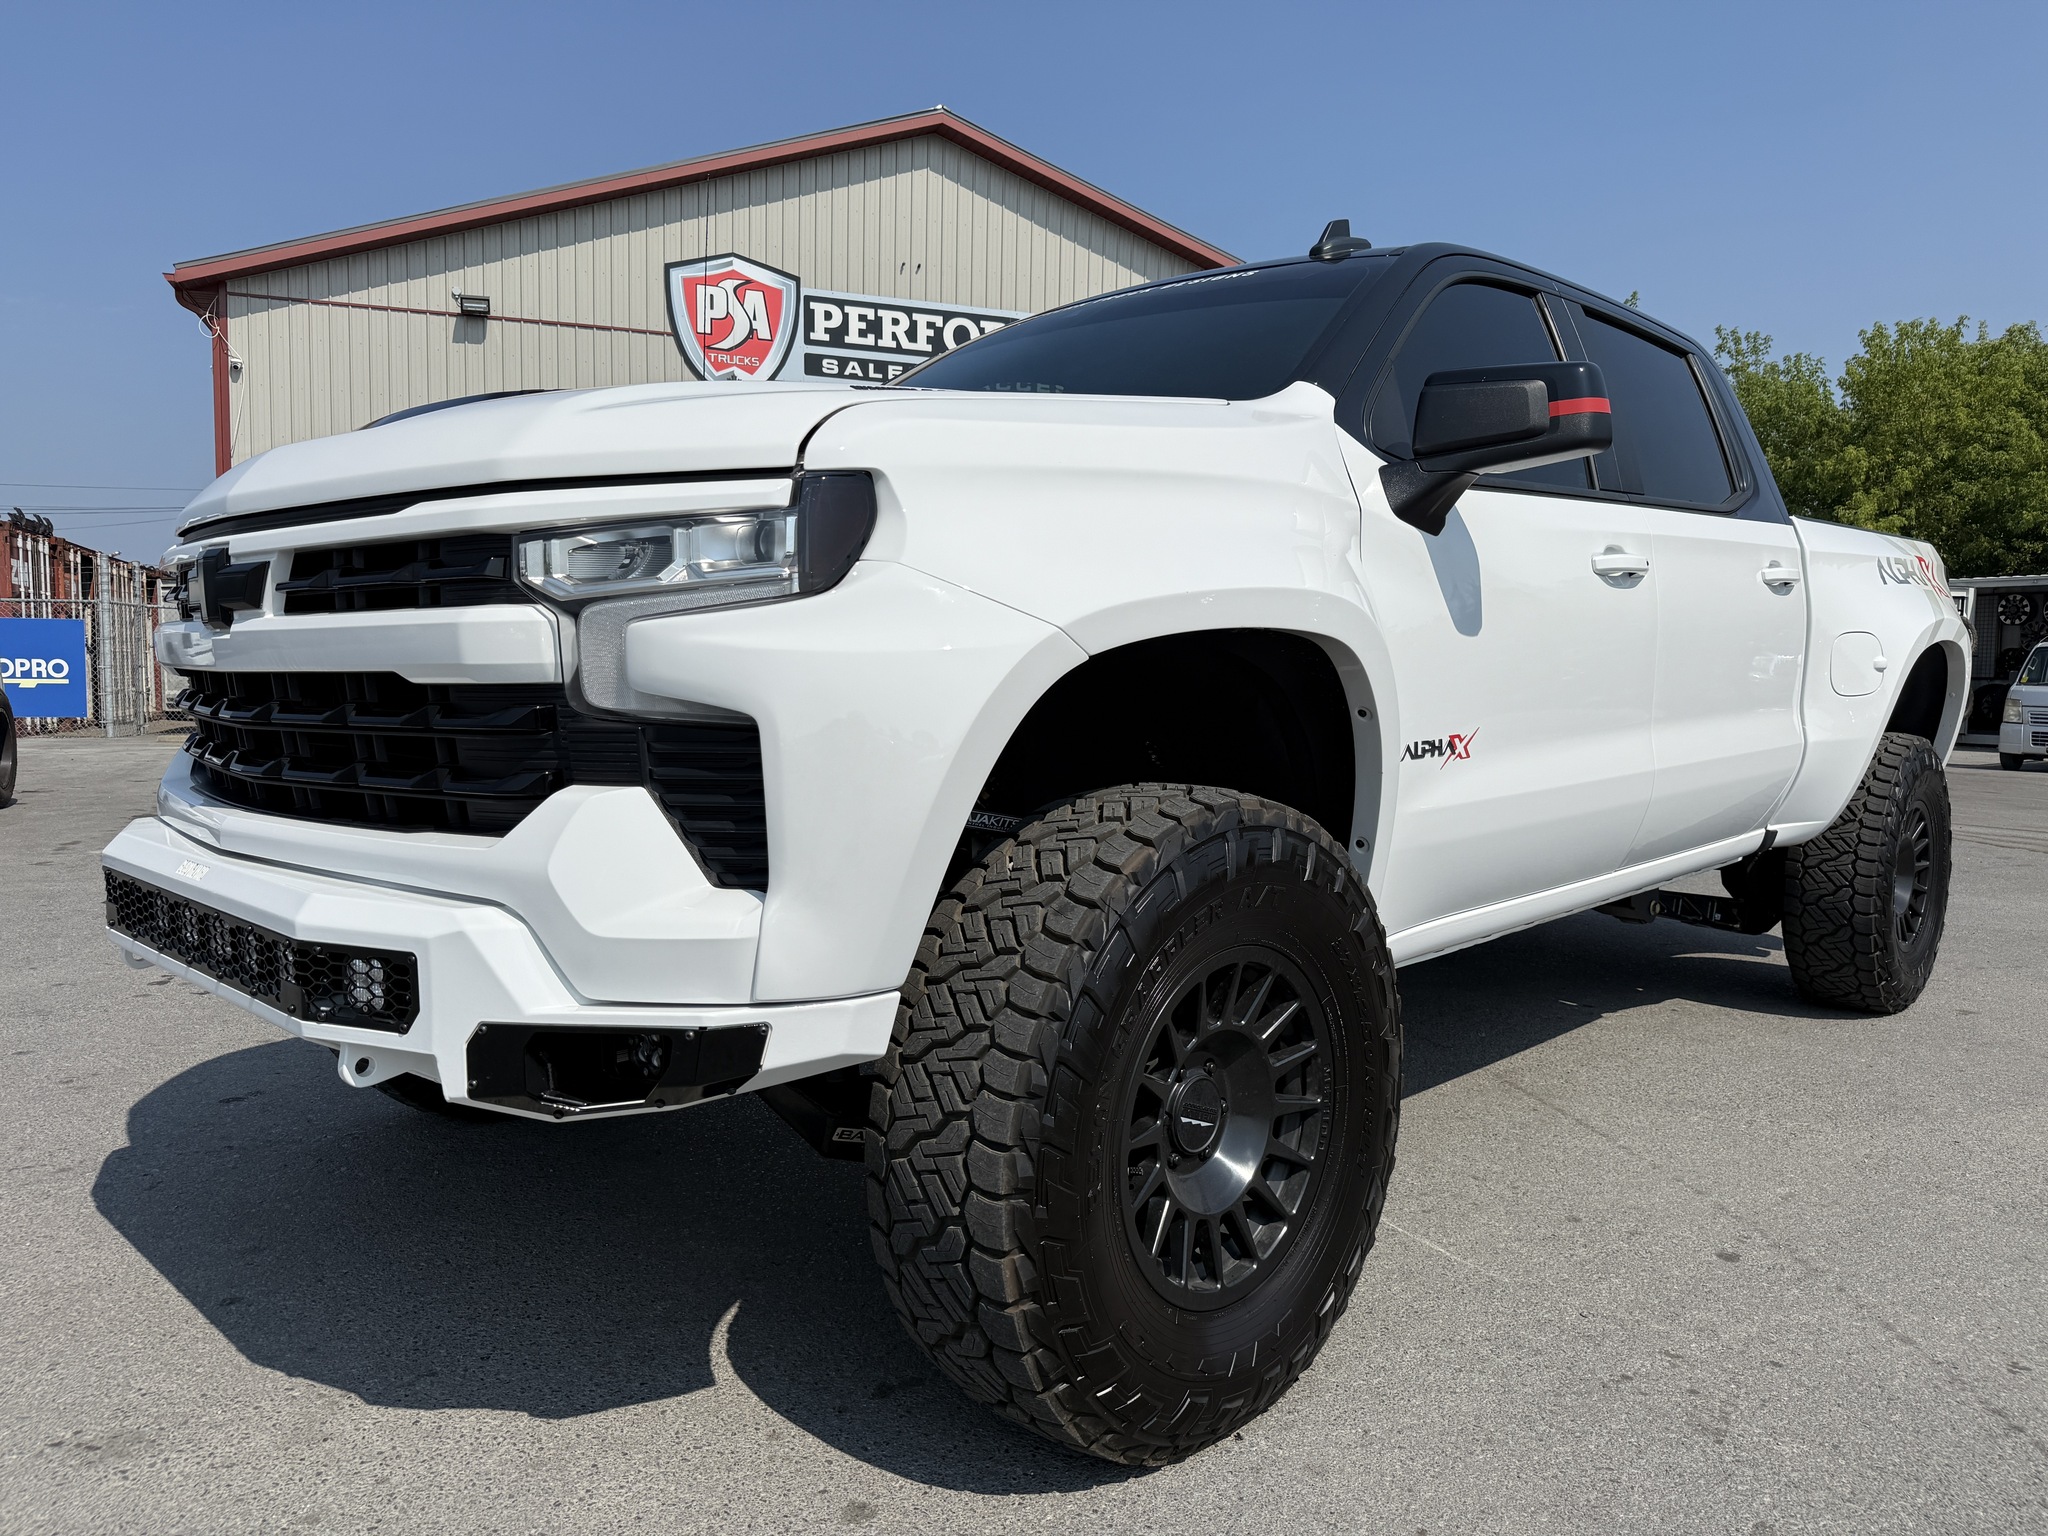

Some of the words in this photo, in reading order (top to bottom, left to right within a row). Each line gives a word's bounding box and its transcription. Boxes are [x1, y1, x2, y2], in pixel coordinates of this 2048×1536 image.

[695, 277, 773, 352] PSA
[810, 301, 1006, 352] PERFO
[708, 352, 760, 367] TRUCKS
